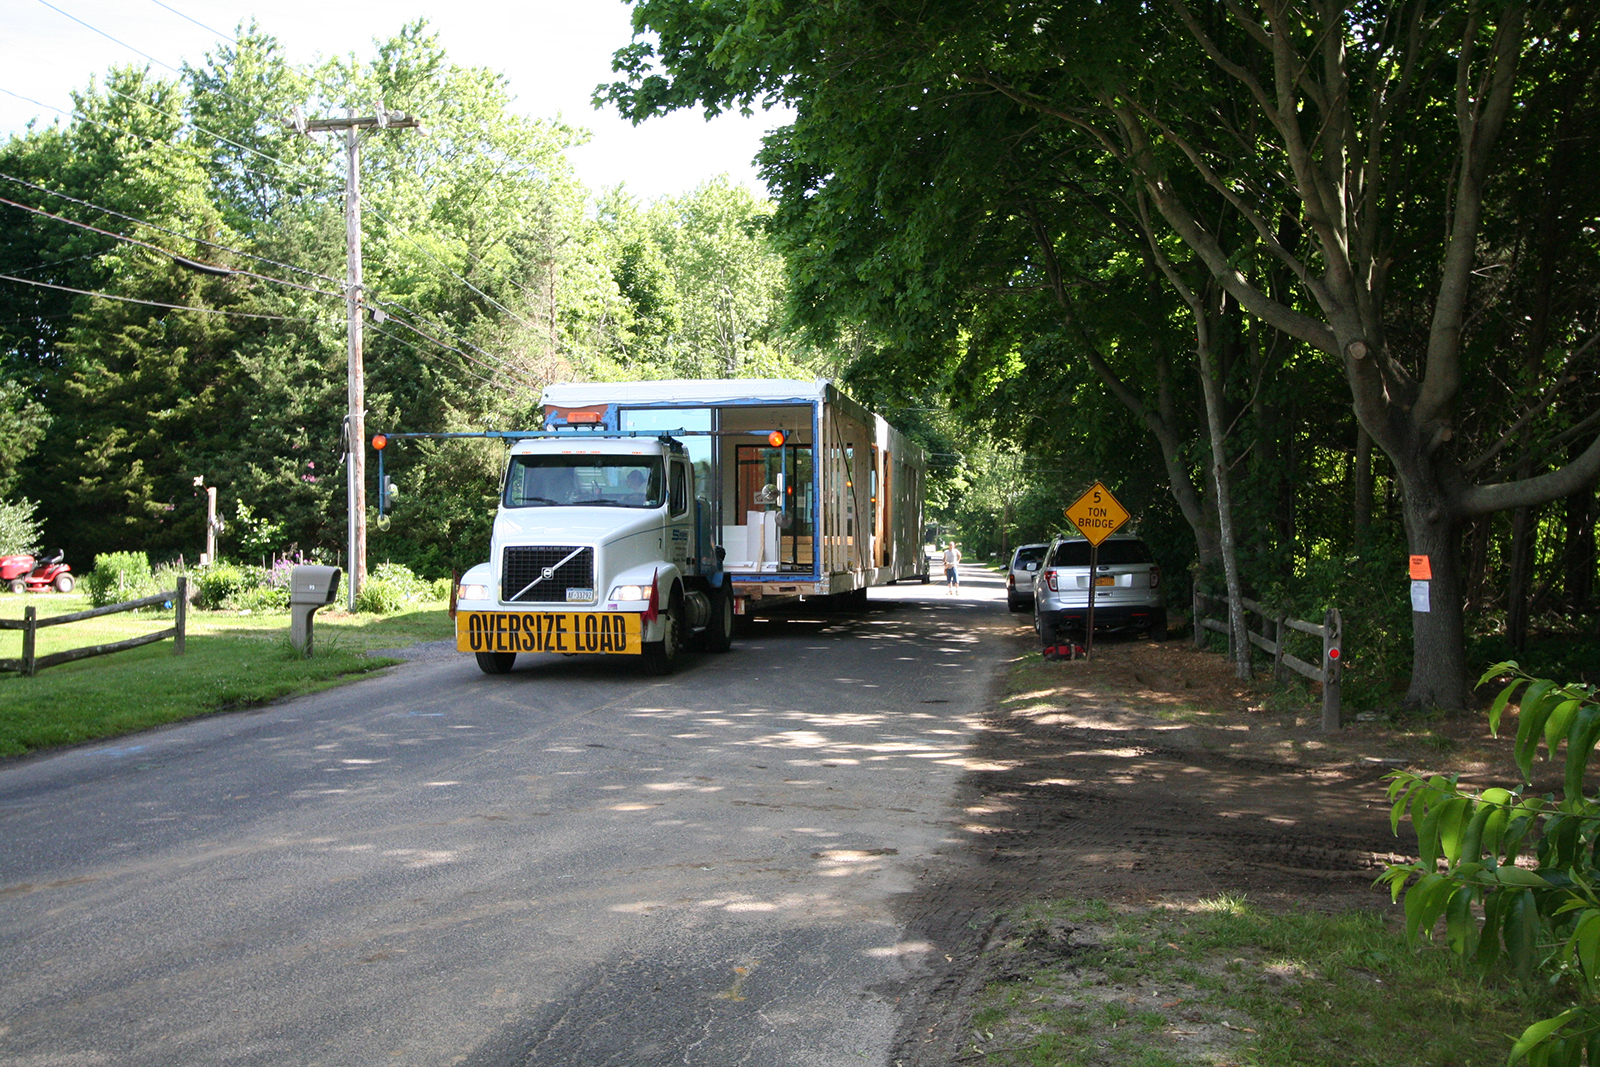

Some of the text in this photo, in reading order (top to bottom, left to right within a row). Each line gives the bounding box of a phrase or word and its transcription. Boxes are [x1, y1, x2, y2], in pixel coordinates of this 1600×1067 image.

[1093, 492, 1101, 503] 5
[1088, 508, 1107, 517] TON
[1078, 518, 1114, 528] BRIDGE
[469, 614, 626, 652] OVERSIZE LOAD
